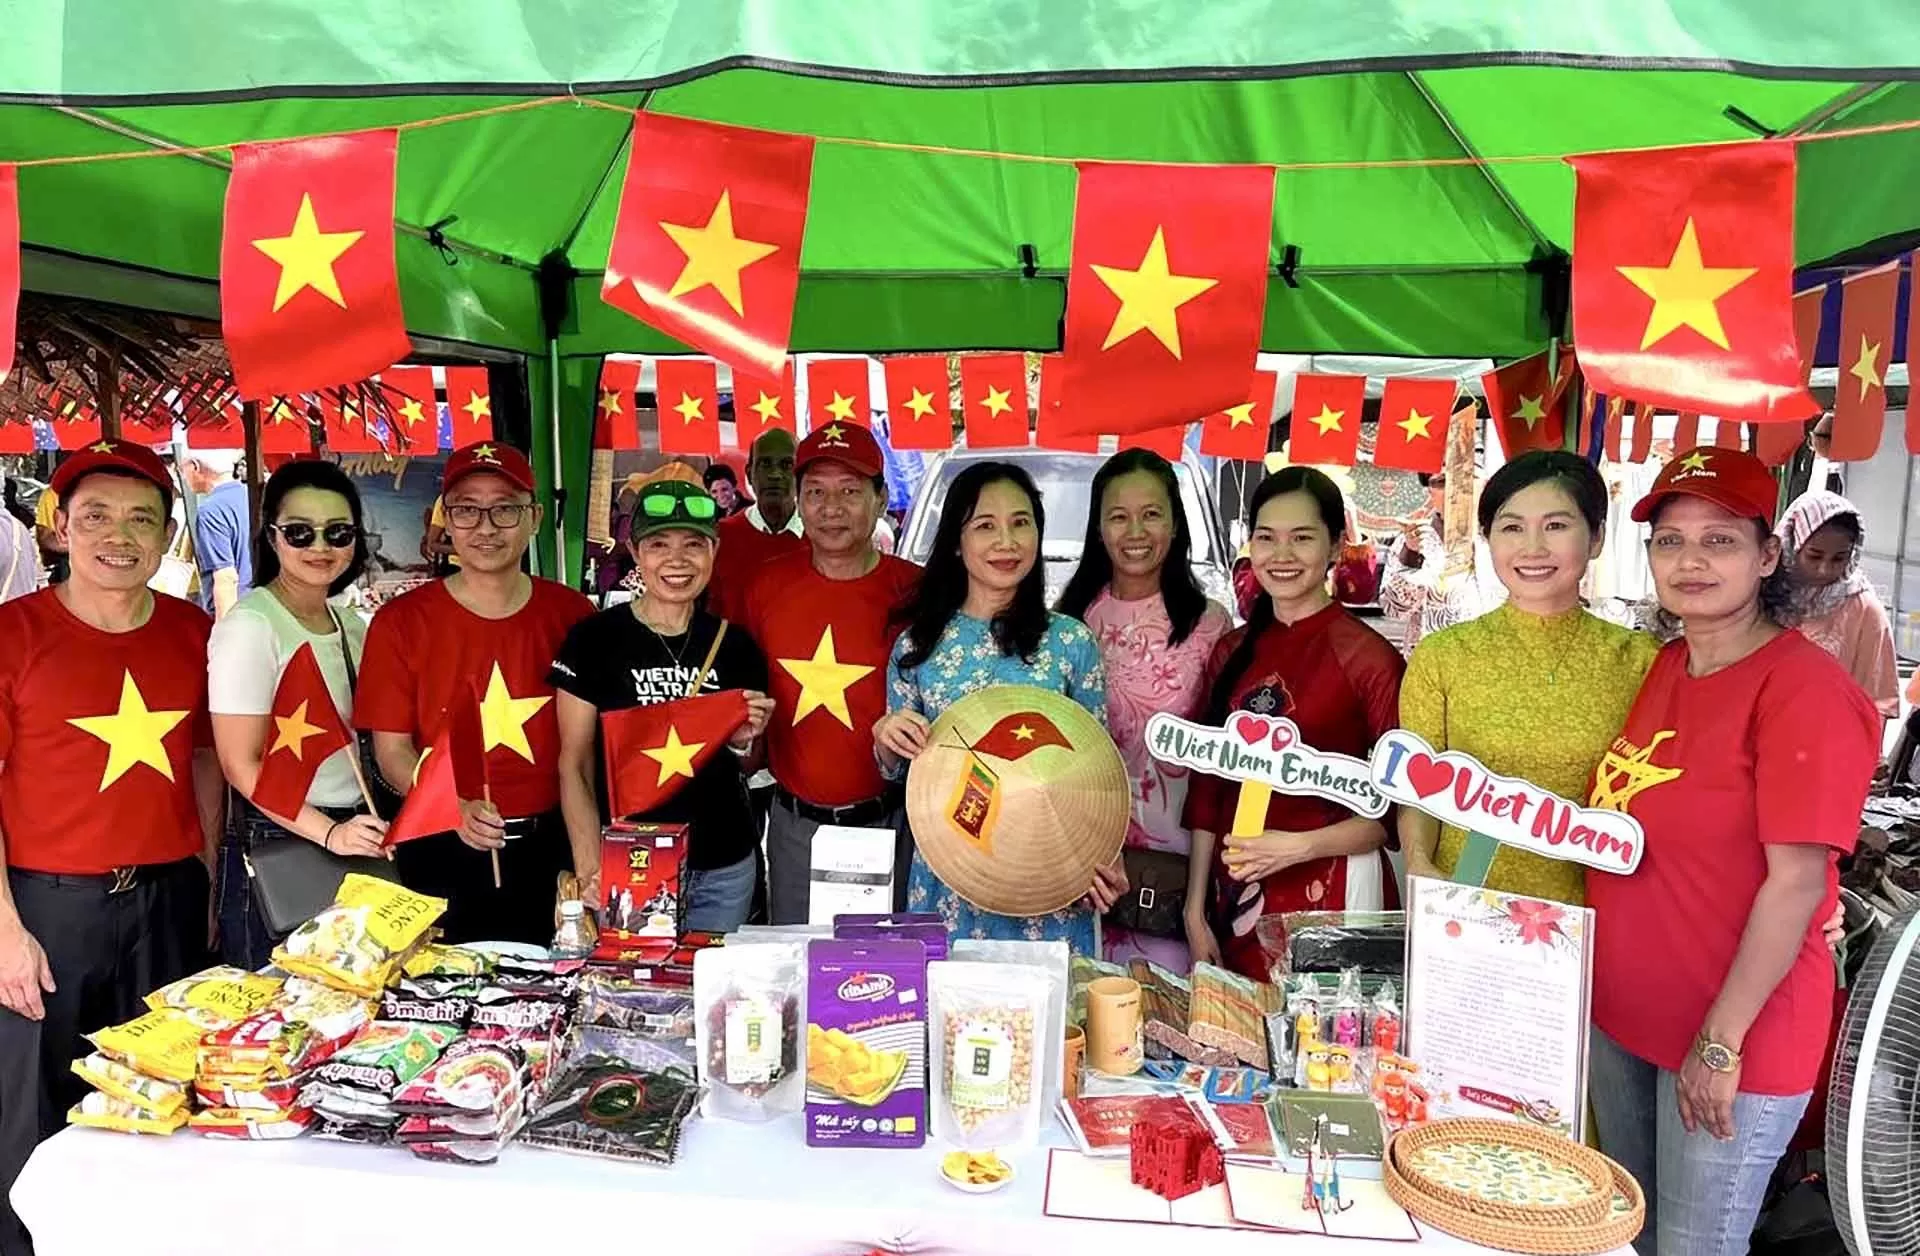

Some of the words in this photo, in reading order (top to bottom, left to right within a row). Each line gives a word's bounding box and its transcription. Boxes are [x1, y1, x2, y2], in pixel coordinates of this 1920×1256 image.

[631, 667, 719, 682] VIETNAM
[1280, 752, 1384, 809] Embassy
[1379, 740, 1410, 788] I
[385, 1001, 454, 1021] Omachi
